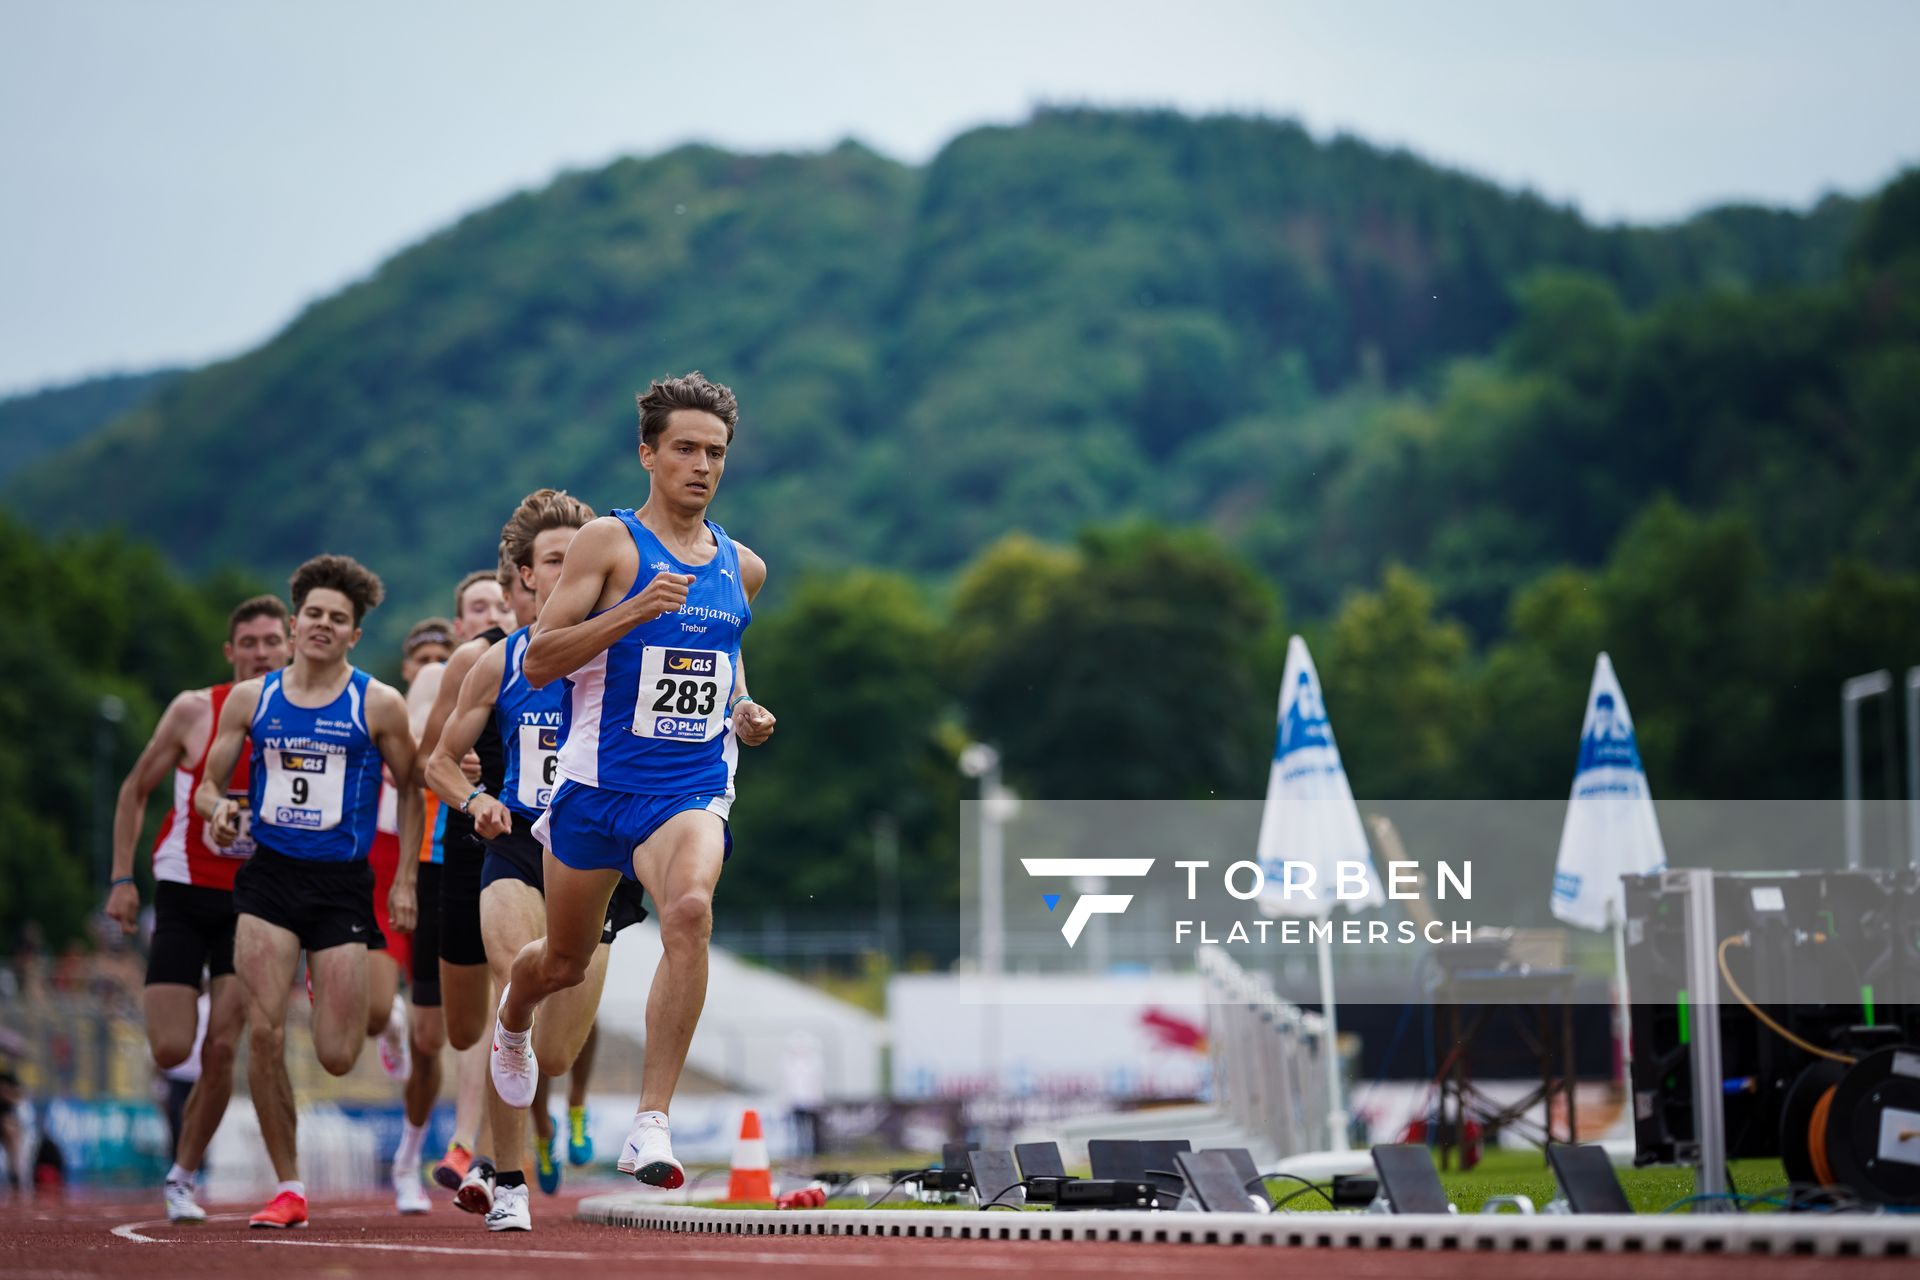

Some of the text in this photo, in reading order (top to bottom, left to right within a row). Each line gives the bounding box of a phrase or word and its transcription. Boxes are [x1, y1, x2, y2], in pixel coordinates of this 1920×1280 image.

[677, 603, 741, 628] Benjamin
[680, 622, 707, 633] Trebur
[691, 658, 712, 672] GLS
[652, 678, 717, 716] 283
[522, 712, 541, 725] TV
[677, 721, 706, 733] PLAN
[264, 736, 347, 755] TV Villingen
[301, 758, 323, 771] GLS
[291, 777, 309, 805] 9
[293, 810, 321, 822] PLAN
